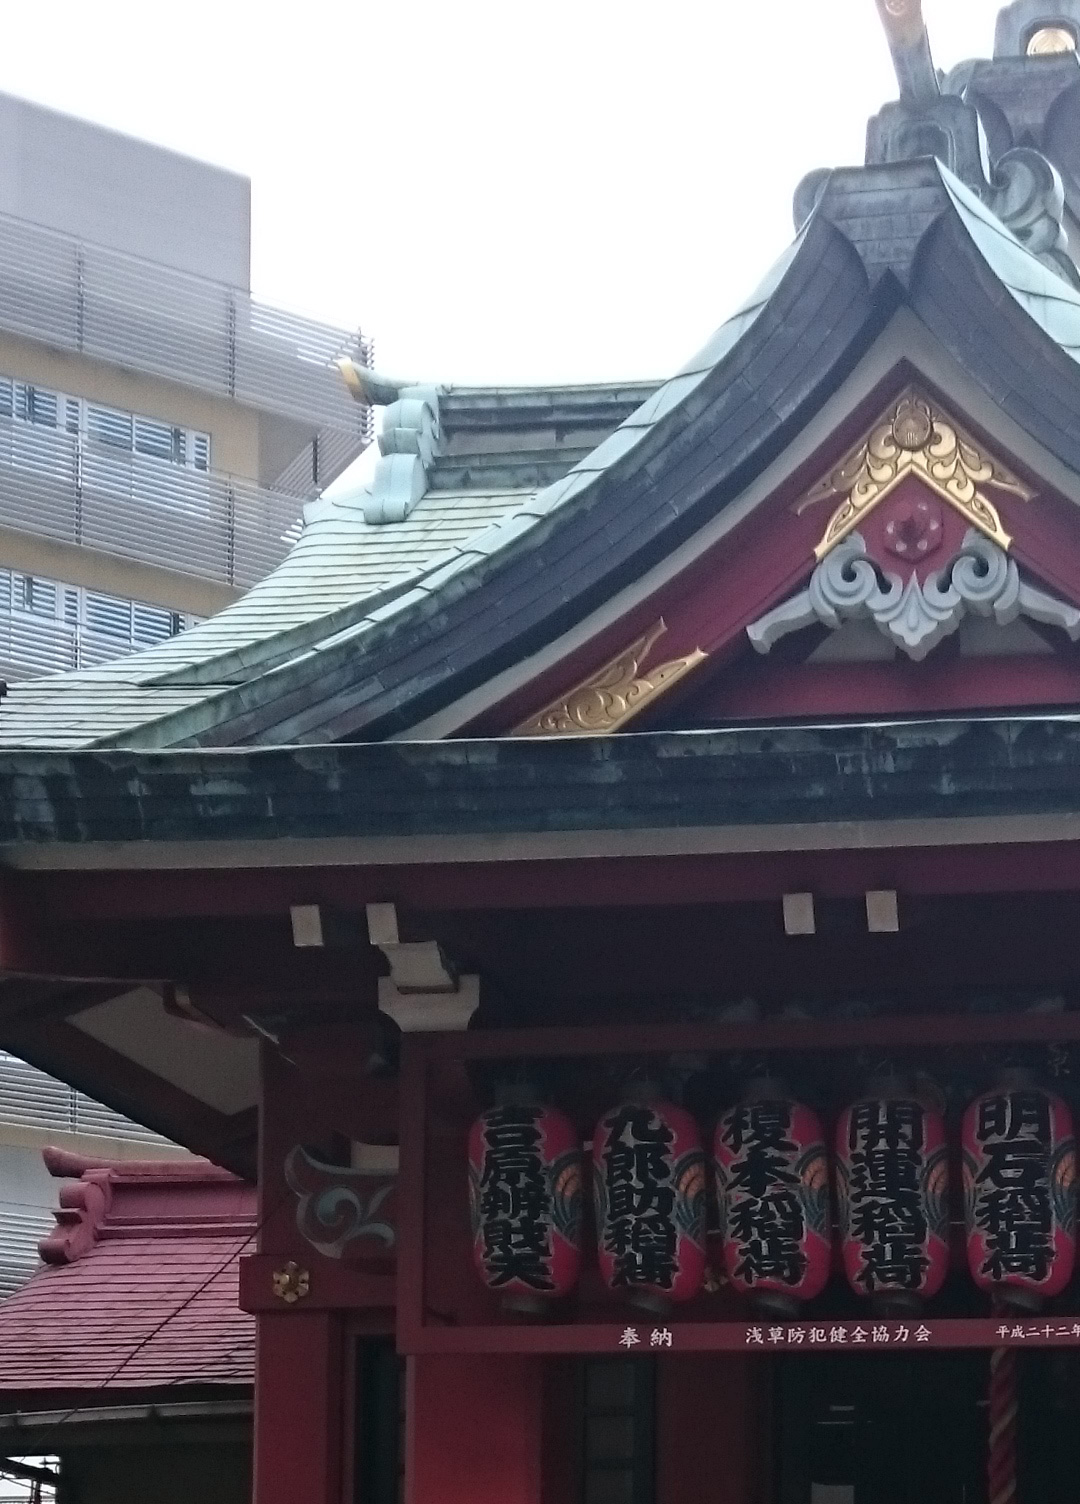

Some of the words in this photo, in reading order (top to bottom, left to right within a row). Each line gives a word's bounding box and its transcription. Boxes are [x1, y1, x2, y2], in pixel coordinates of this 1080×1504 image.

[618, 1327, 673, 1349] 奉納
[745, 1323, 933, 1345] 浅草防犯健全協力会
